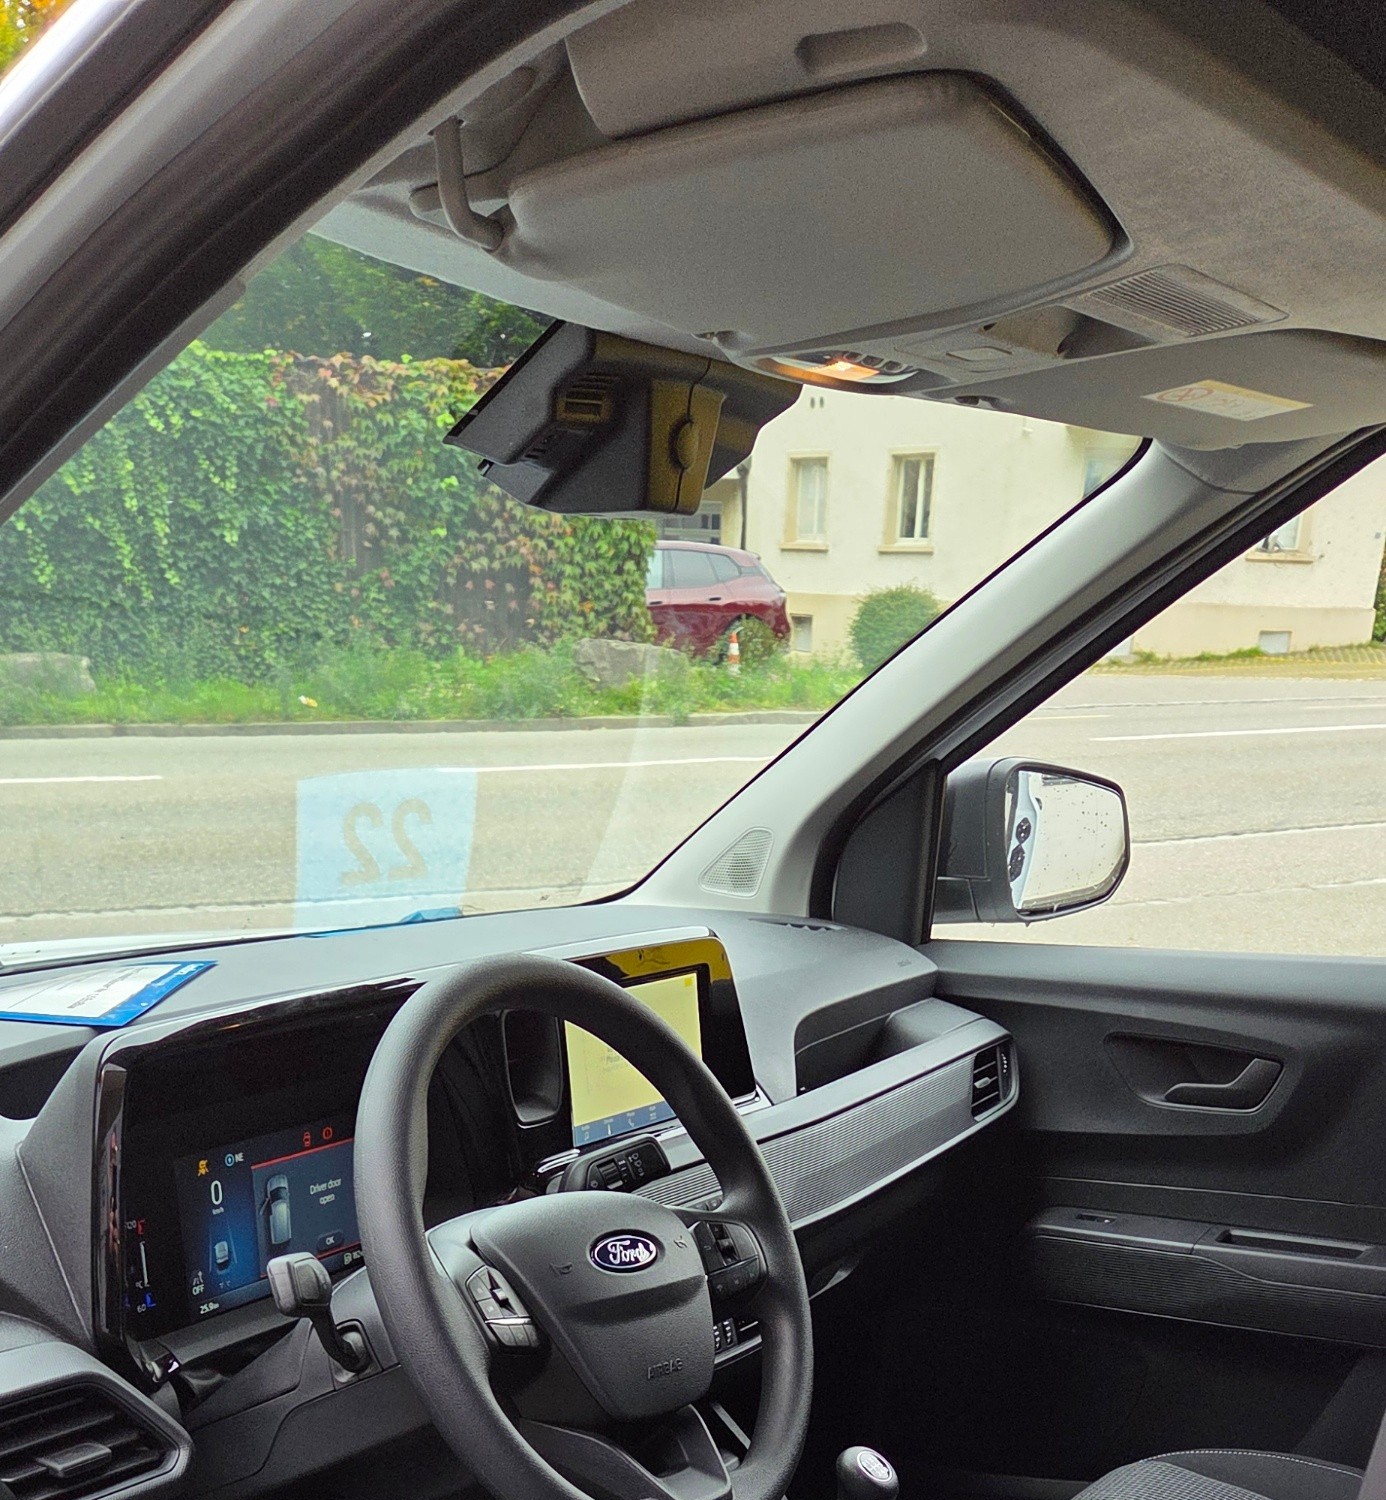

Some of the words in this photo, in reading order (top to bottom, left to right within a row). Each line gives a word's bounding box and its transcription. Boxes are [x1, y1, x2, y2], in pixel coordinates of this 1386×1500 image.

[210, 1180, 223, 1205] 0
[309, 1183, 328, 1195] Driver
[328, 1178, 342, 1190] door
[319, 1193, 336, 1206] open
[325, 1235, 336, 1246] OK
[607, 1239, 655, 1265] Ford
[192, 1284, 205, 1296] OFF
[136, 1303, 147, 1313] 60
